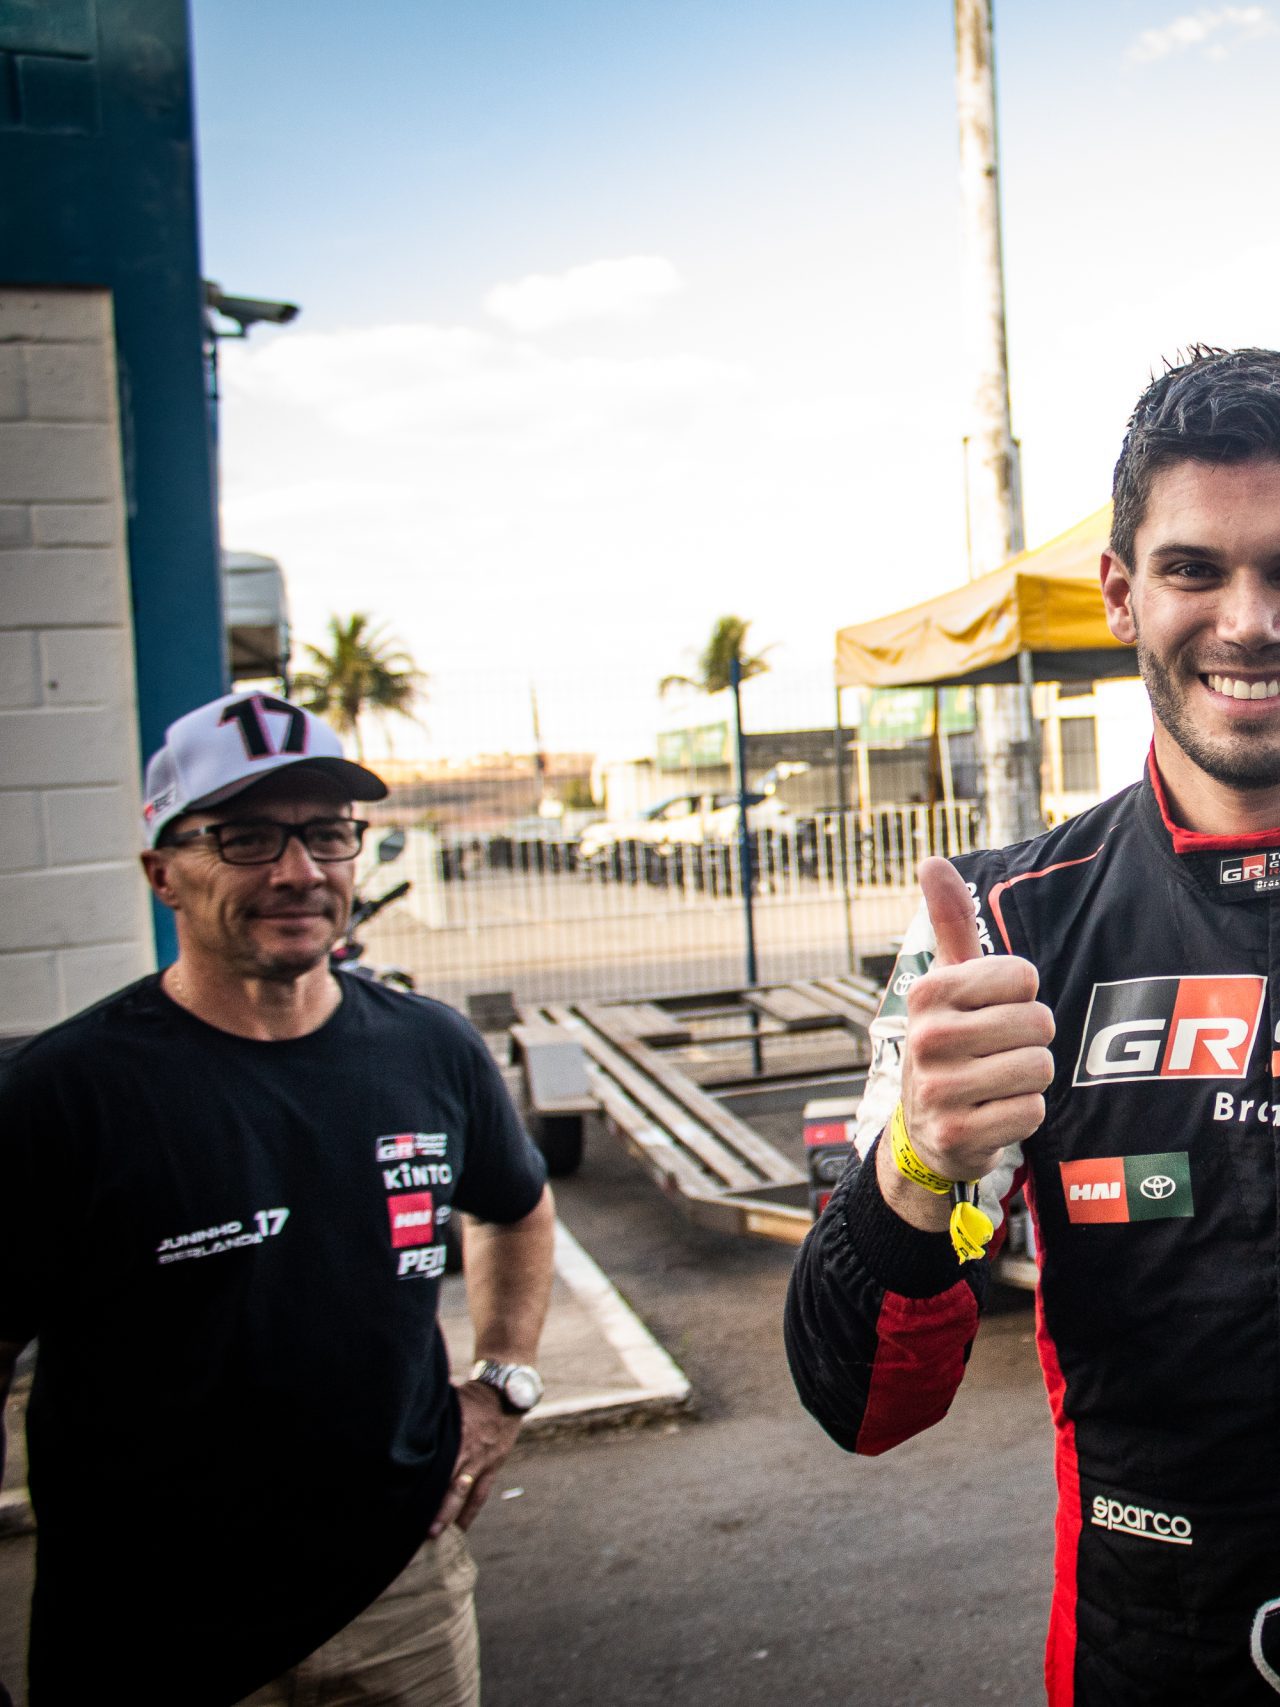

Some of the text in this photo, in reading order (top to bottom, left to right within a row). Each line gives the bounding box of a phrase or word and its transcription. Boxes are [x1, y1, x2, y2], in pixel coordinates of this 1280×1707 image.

[217, 695, 311, 761] 17
[1222, 864, 1264, 882] GR
[1086, 1018, 1249, 1076] GR
[379, 1142, 415, 1160] GR
[157, 1220, 243, 1252] JUNINHO
[254, 1207, 290, 1237] 17
[1091, 1495, 1192, 1540] sparco
